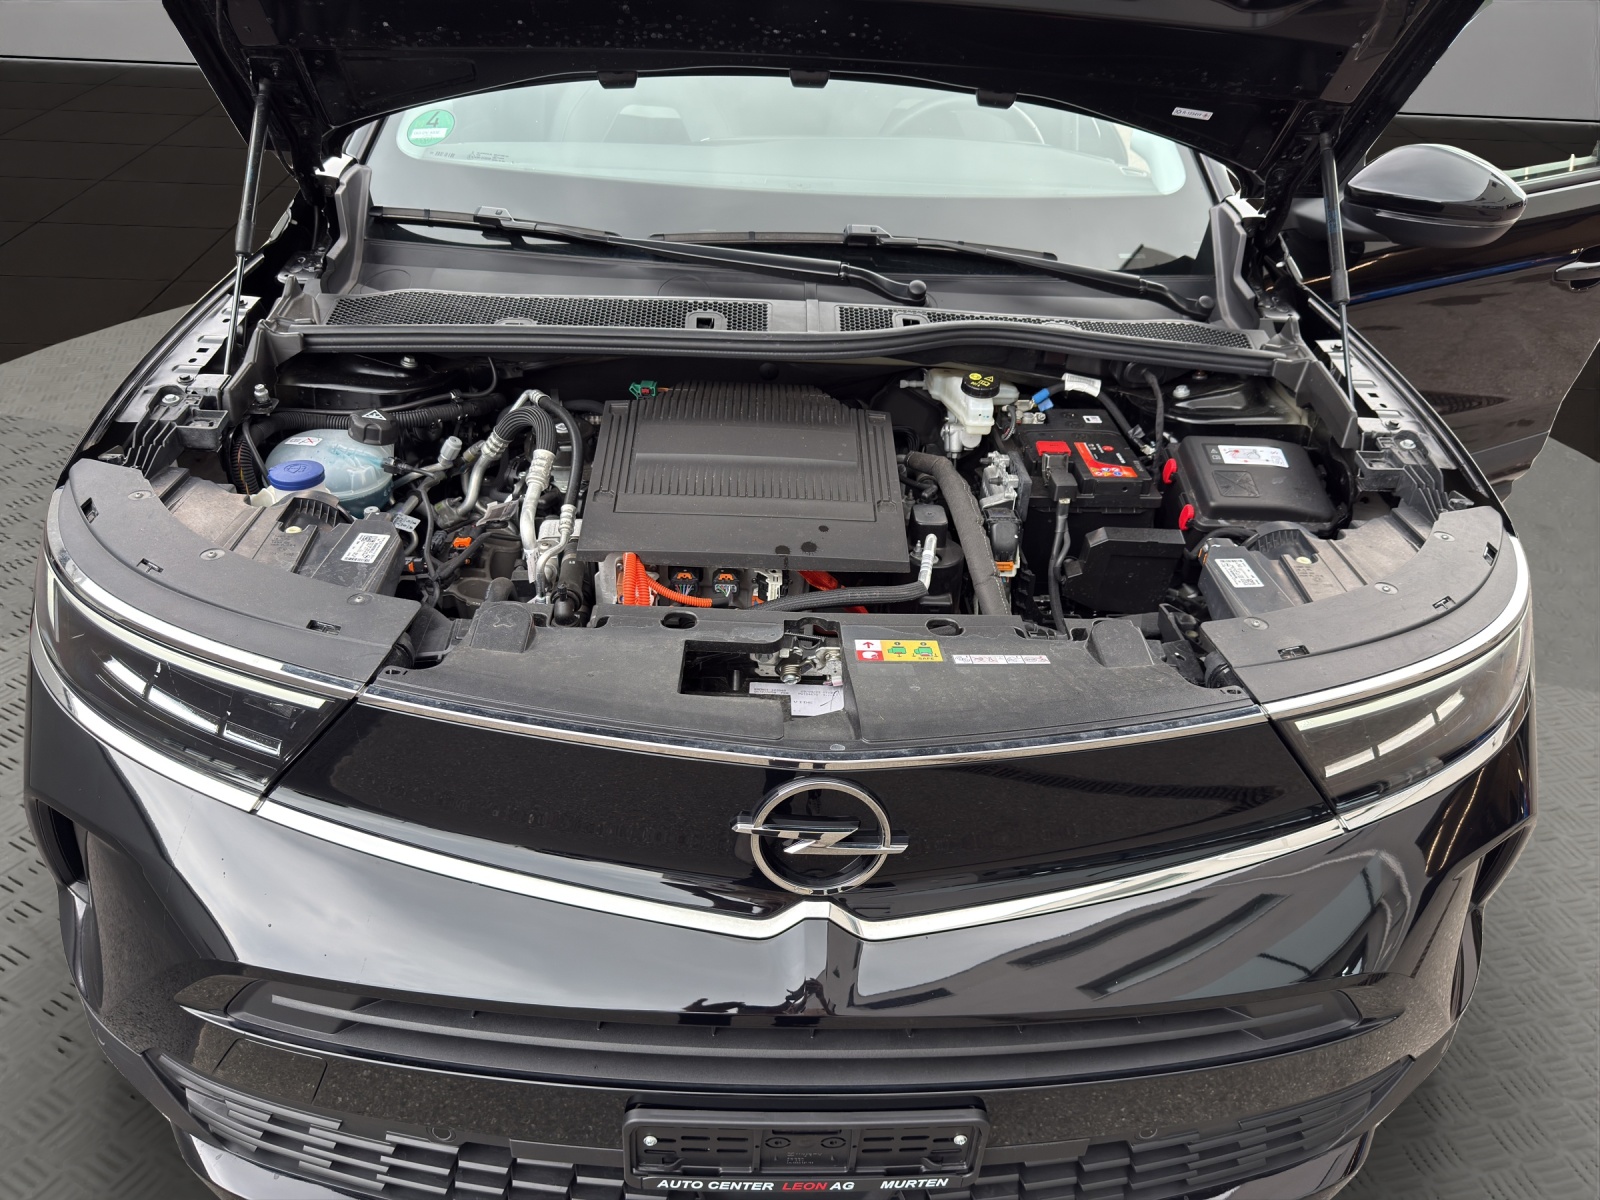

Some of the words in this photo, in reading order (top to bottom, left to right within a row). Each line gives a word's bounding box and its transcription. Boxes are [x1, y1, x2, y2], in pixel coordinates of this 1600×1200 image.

[426, 110, 439, 128] 4
[657, 1179, 704, 1189] AUTO
[708, 1181, 775, 1191] CENTER
[782, 1182, 828, 1191] LEON
[829, 1182, 855, 1191] AG
[880, 1178, 949, 1190] MURTEN
